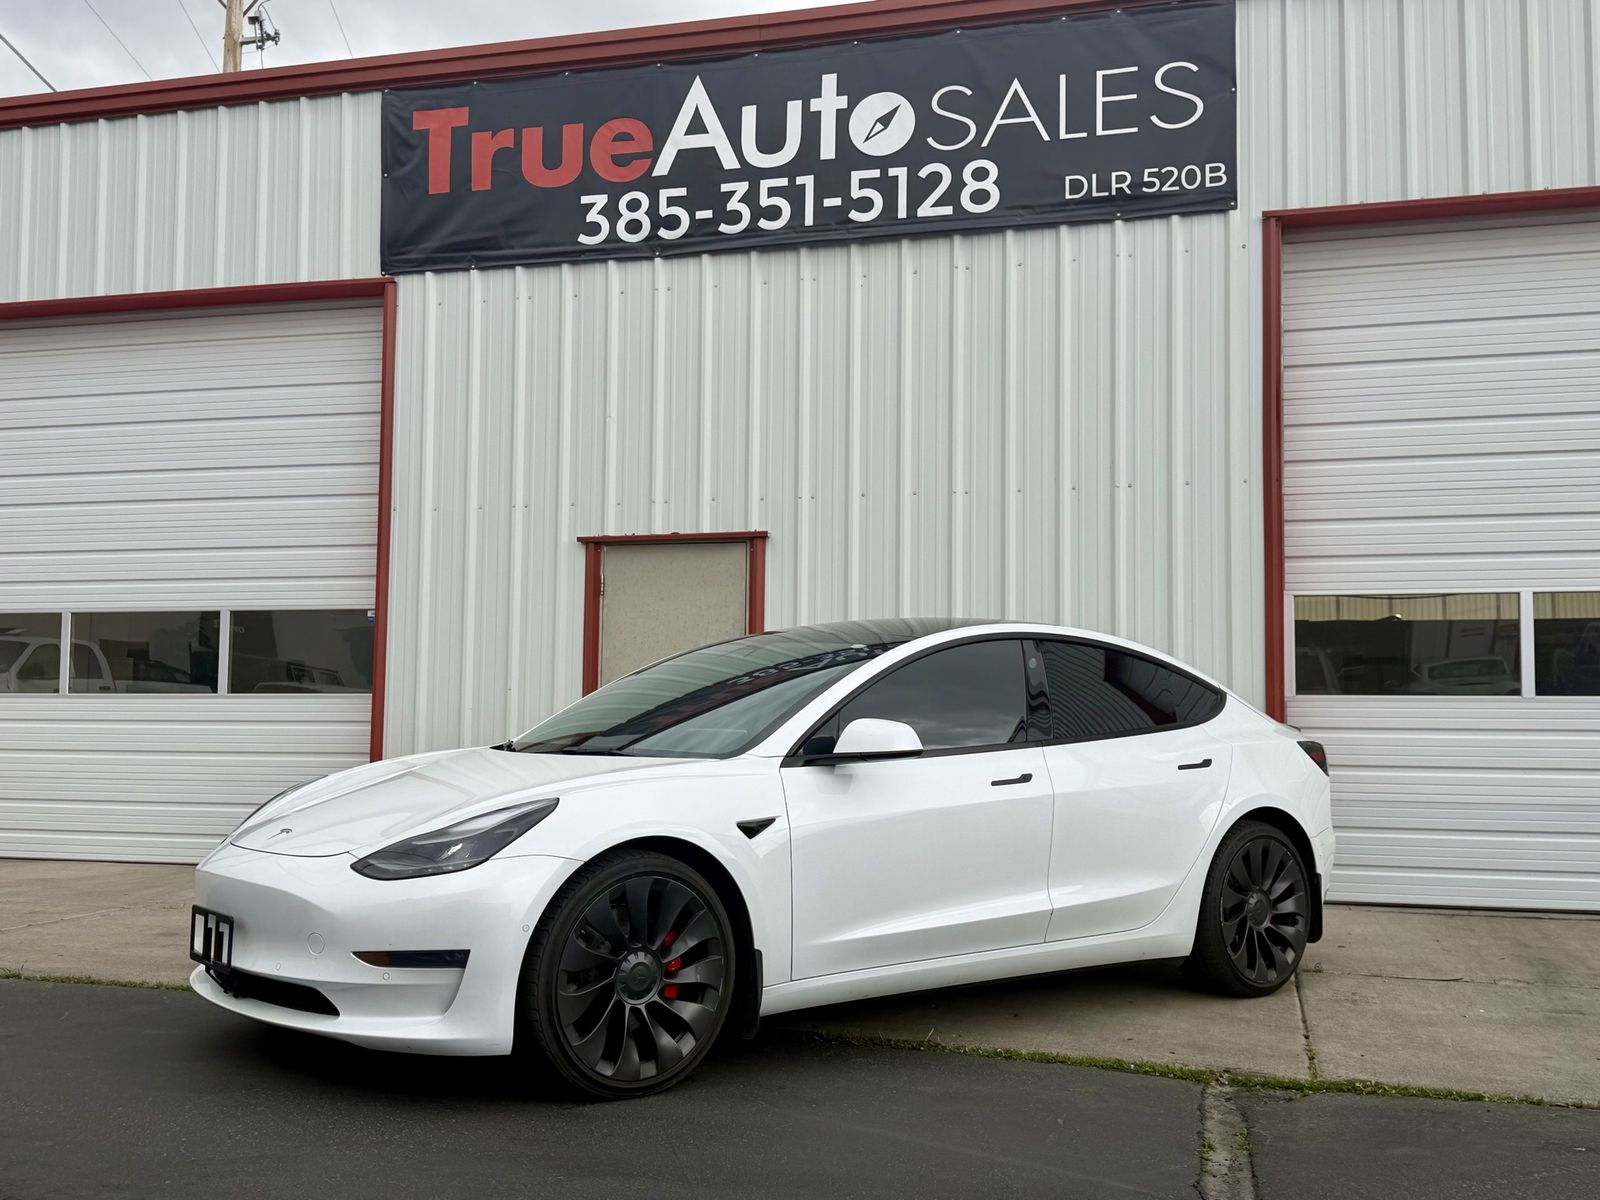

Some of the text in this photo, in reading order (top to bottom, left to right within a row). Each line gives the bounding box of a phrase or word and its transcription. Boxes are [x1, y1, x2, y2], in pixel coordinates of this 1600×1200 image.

[926, 61, 1204, 151] SALES
[577, 159, 1001, 245] 385-351-5128
[1065, 162, 1228, 200] DLR 520B
